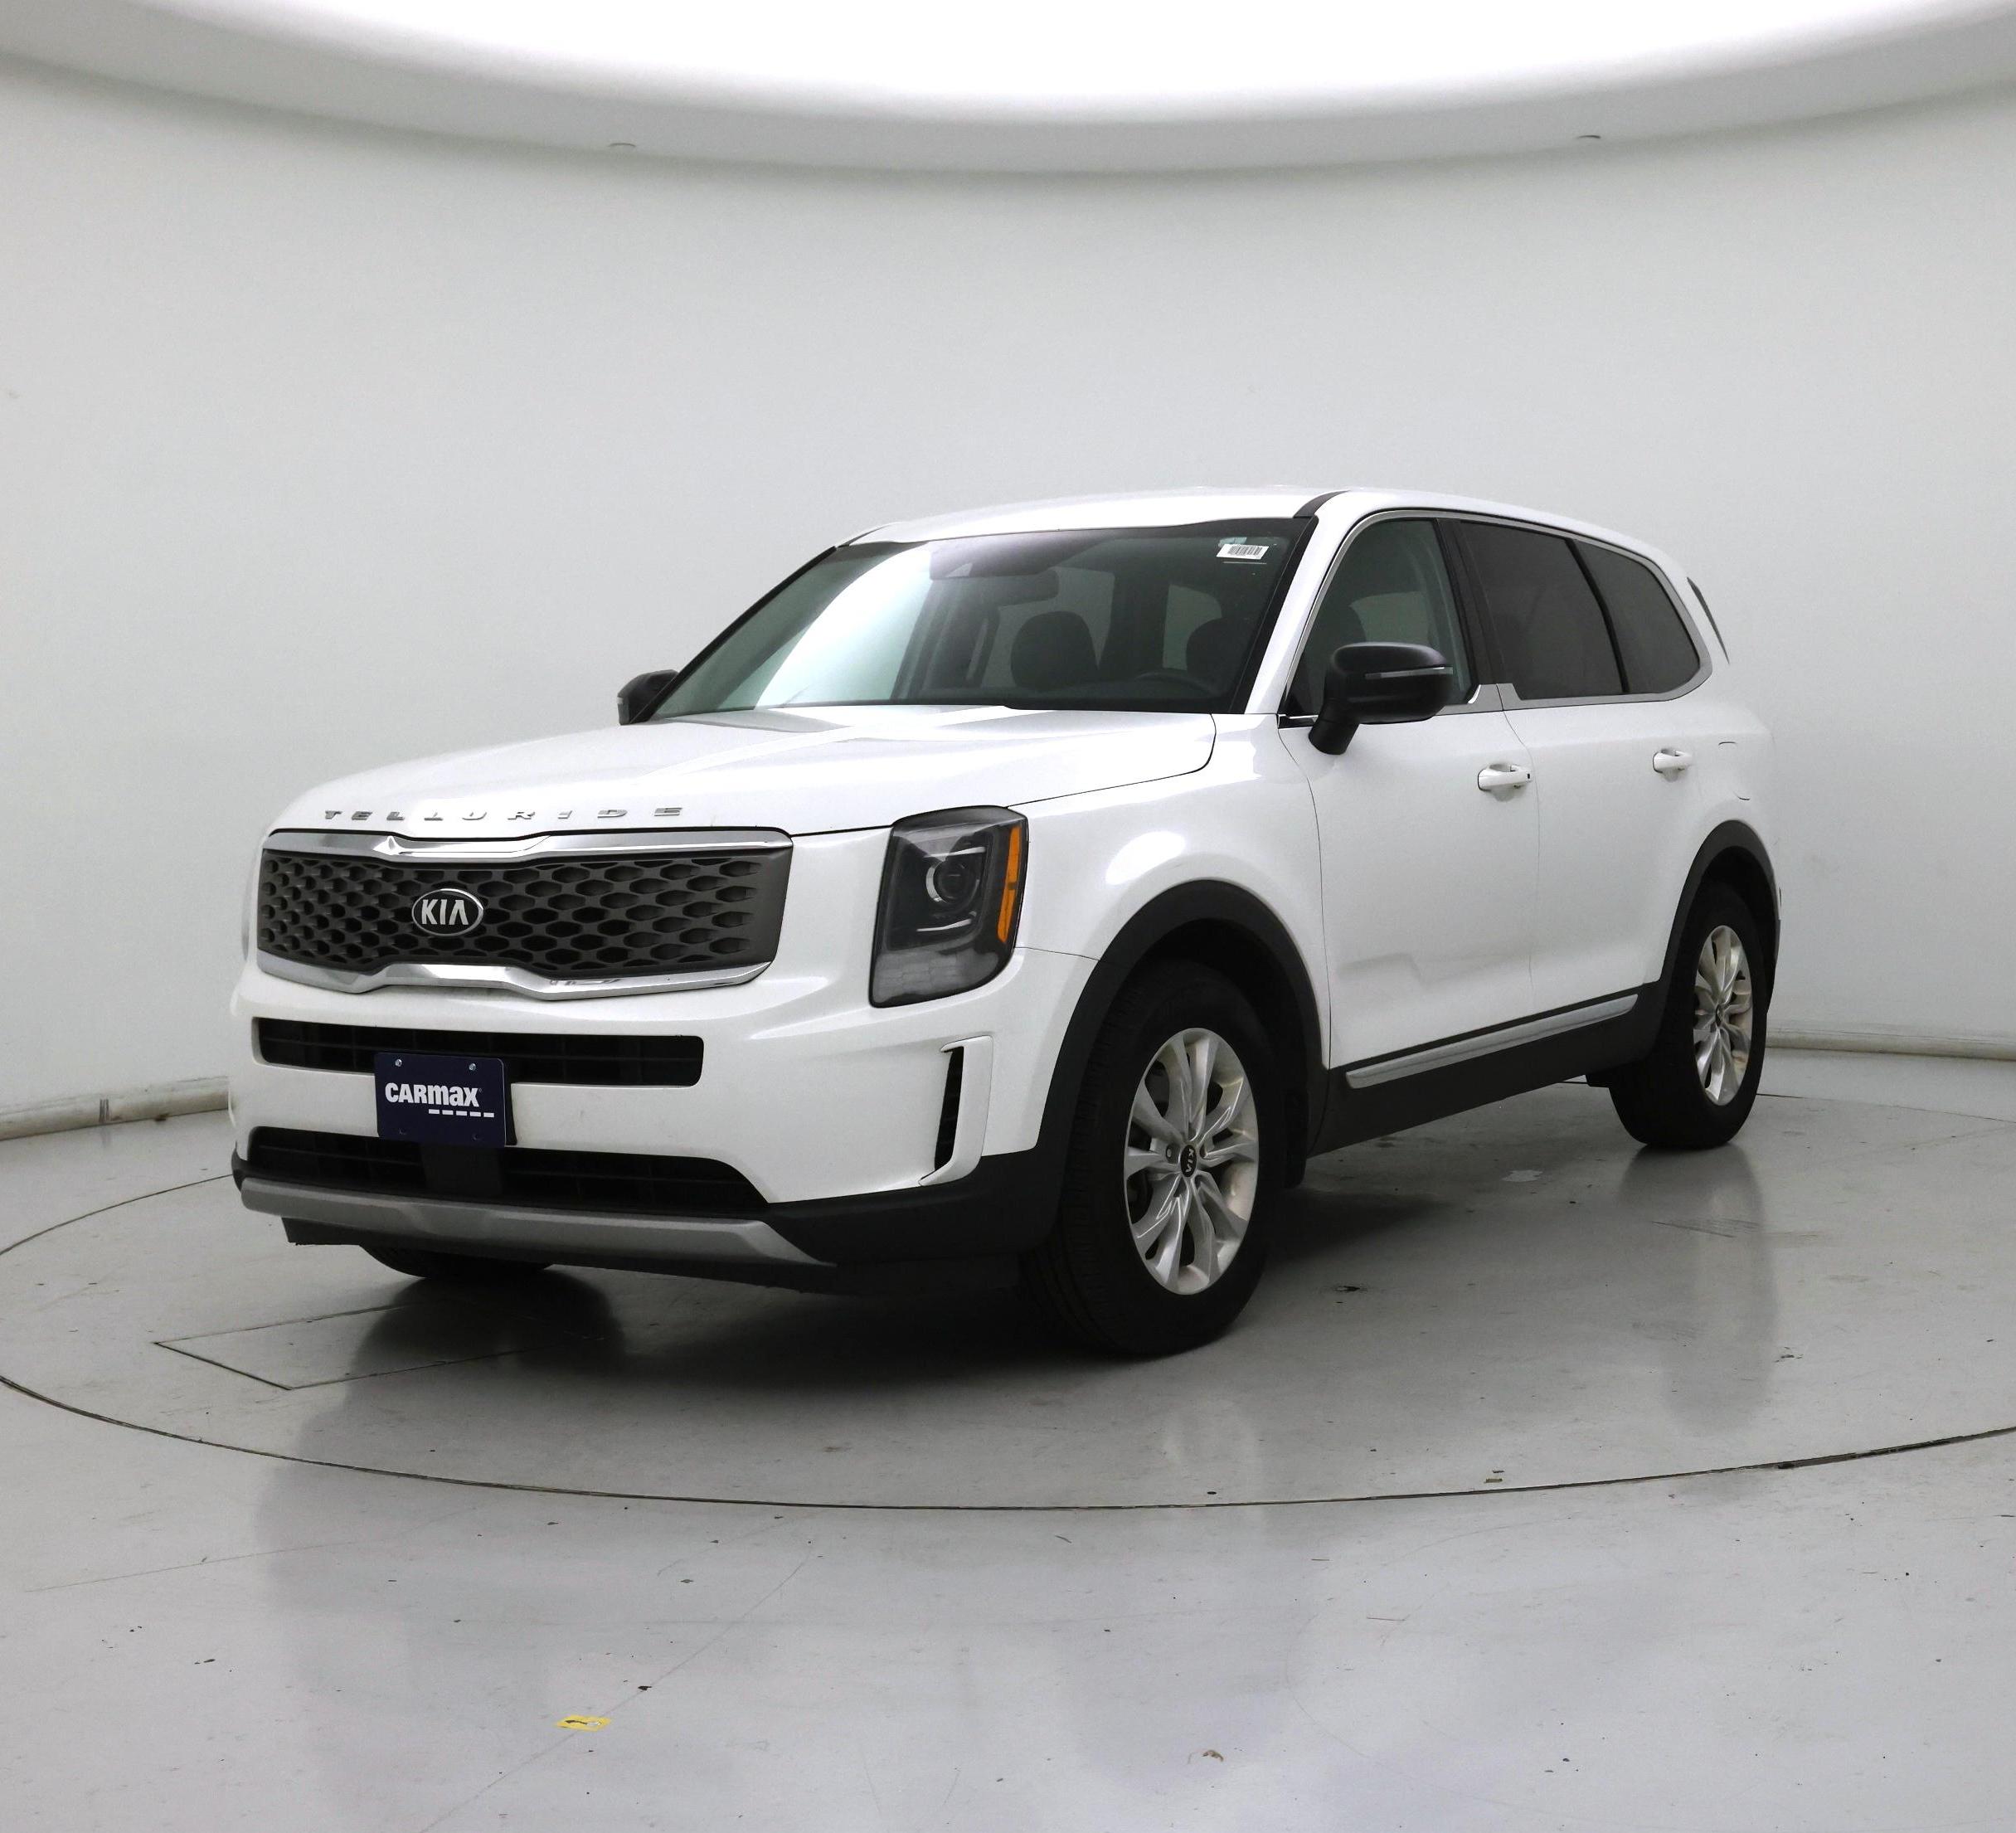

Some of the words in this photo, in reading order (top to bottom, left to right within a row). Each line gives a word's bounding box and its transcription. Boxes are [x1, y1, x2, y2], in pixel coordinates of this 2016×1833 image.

[324, 807, 683, 821] TELLURIDE
[421, 899, 469, 925] KIA
[1186, 1148, 1194, 1172] KIA
